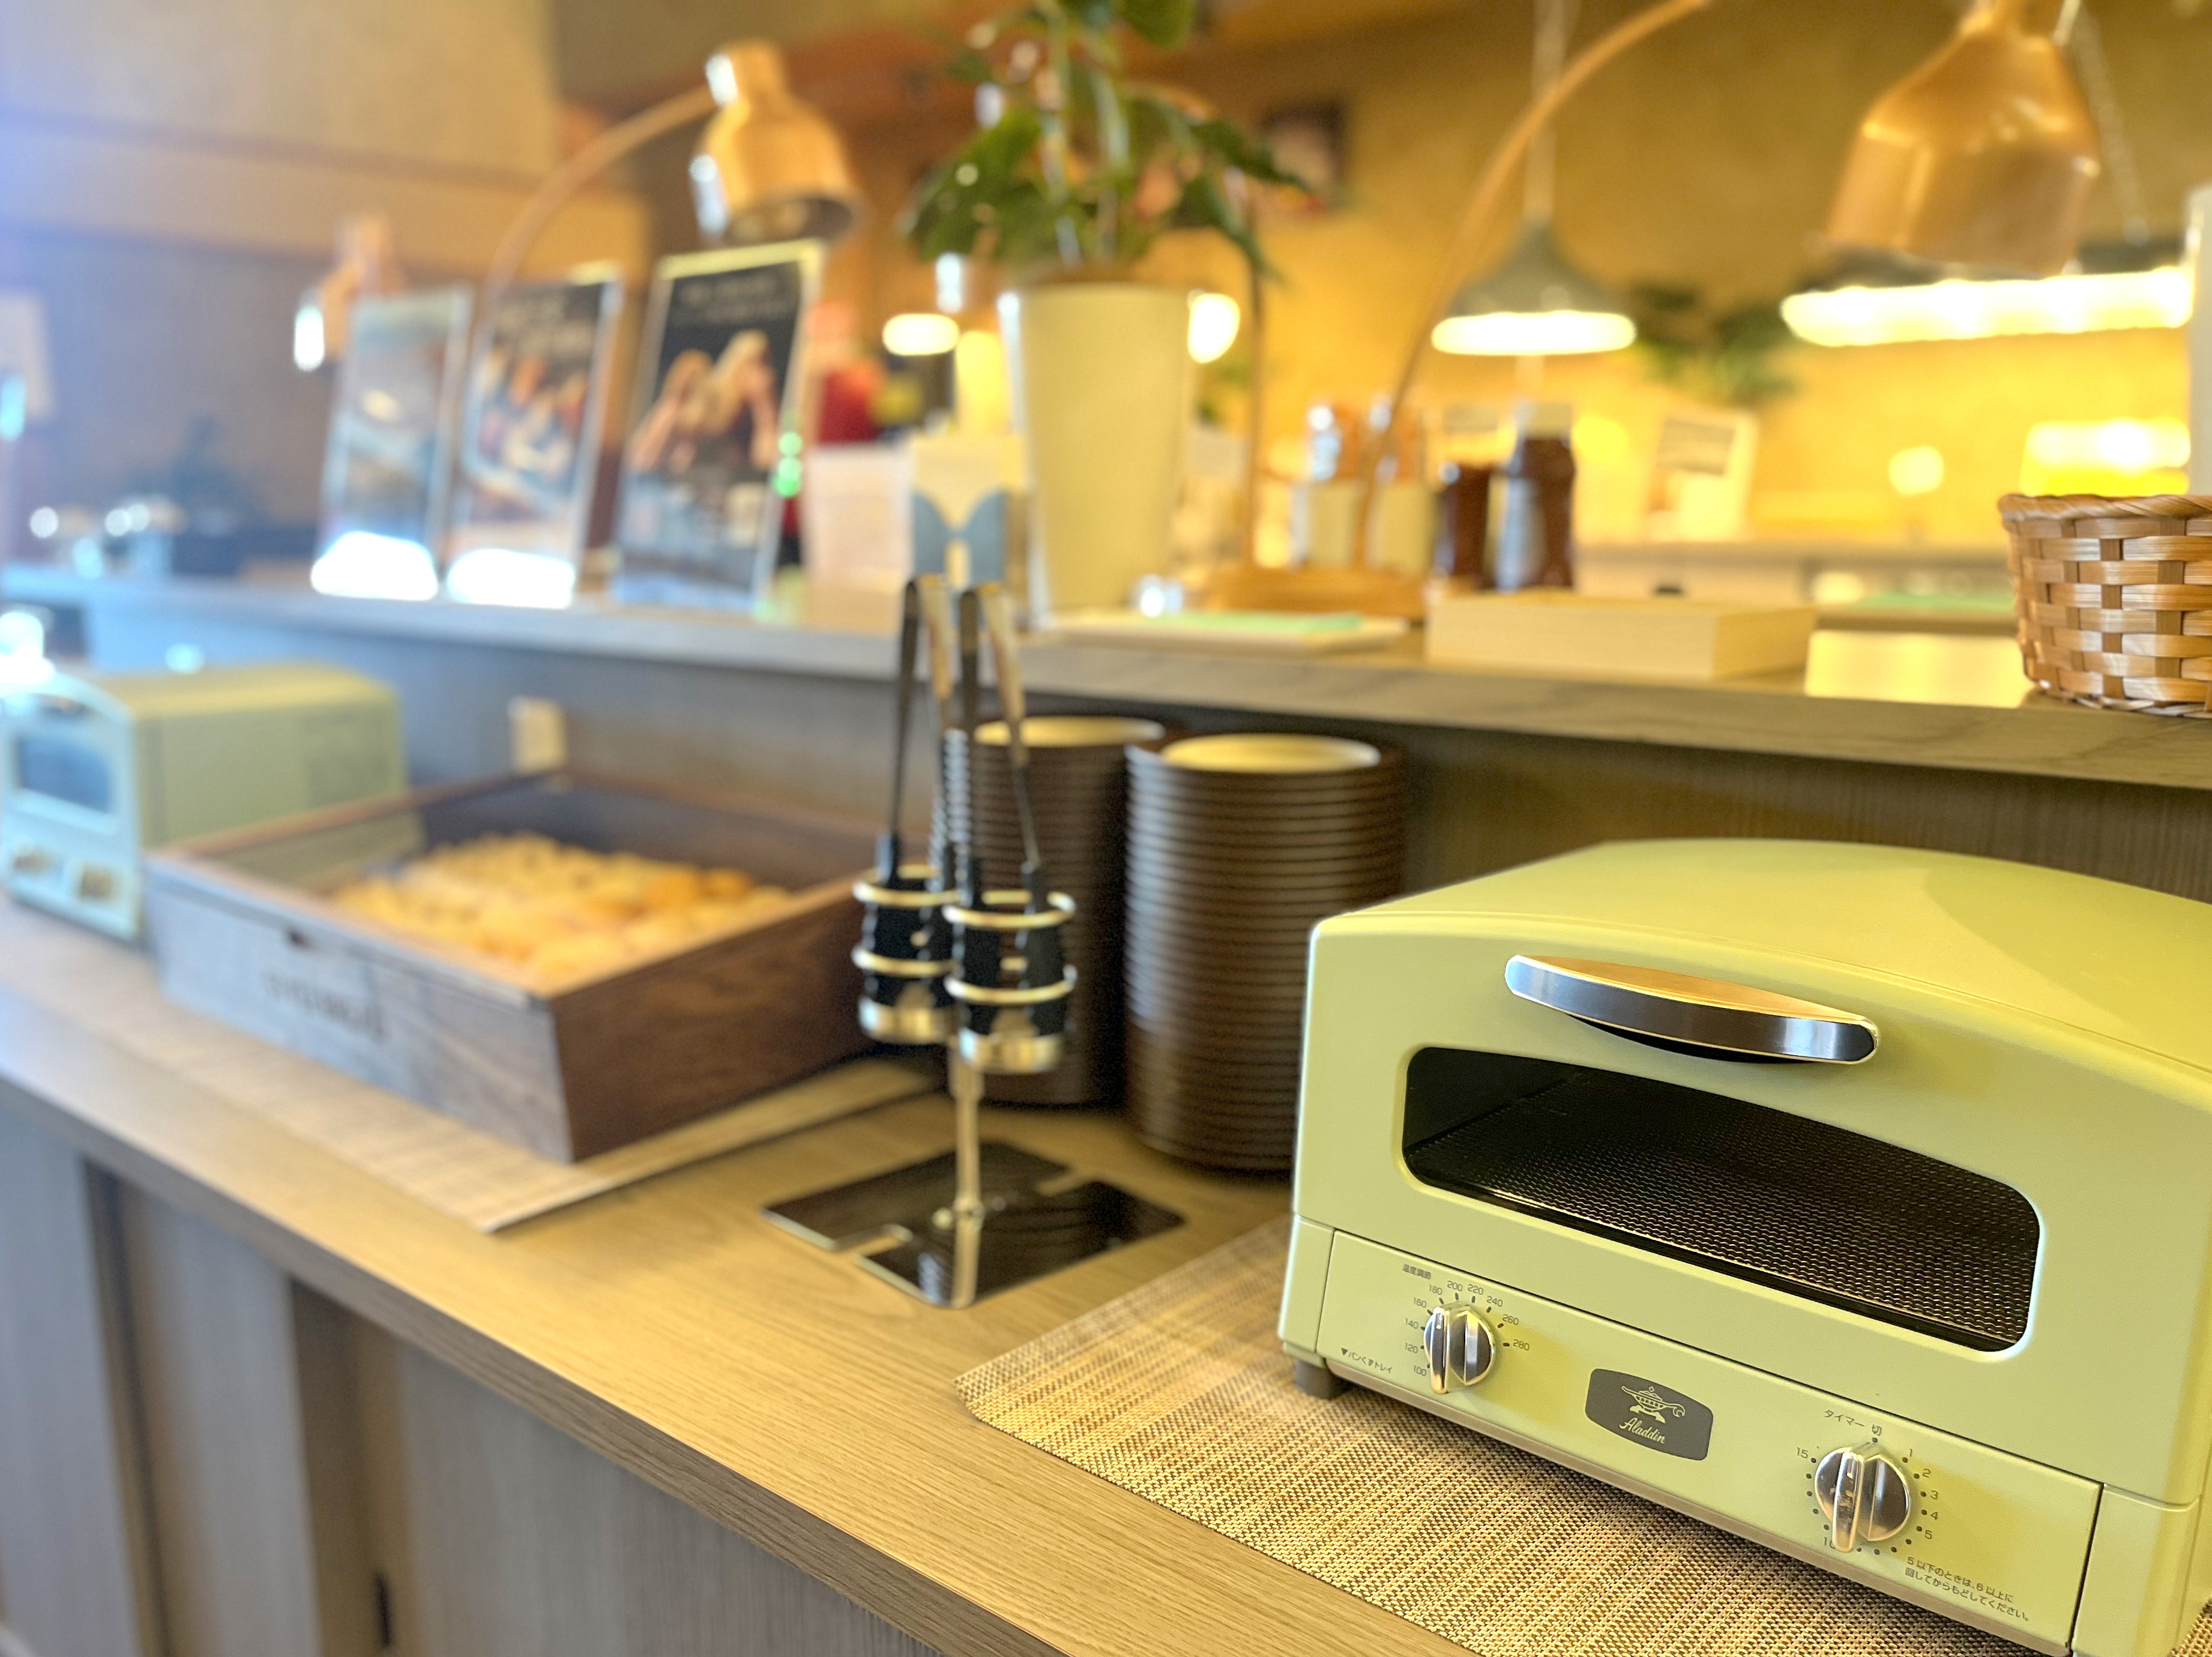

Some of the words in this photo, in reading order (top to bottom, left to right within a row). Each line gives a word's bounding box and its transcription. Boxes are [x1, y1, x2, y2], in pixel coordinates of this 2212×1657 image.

[1429, 1284, 1442, 1295] 180
[1447, 1281, 1462, 1292] 200
[1468, 1284, 1483, 1295] 220
[1414, 1298, 1427, 1308] 160
[1487, 1296, 1502, 1307] 240
[1405, 1318, 1418, 1329] 140
[1502, 1314, 1519, 1325] 260
[1405, 1343, 1418, 1353] 120
[1513, 1339, 1529, 1350] 280
[1414, 1365, 1426, 1376] 100
[1825, 1410, 1864, 1427] タイマー
[1620, 1417, 1665, 1444] Aladdin
[1872, 1424, 1882, 1436] 切
[1796, 1448, 1809, 1459] 15
[1908, 1448, 1913, 1457] 1
[1922, 1469, 1931, 1478] 2
[1929, 1490, 1939, 1500] 3
[1930, 1511, 1939, 1520] 4
[1924, 1530, 1932, 1540] 5
